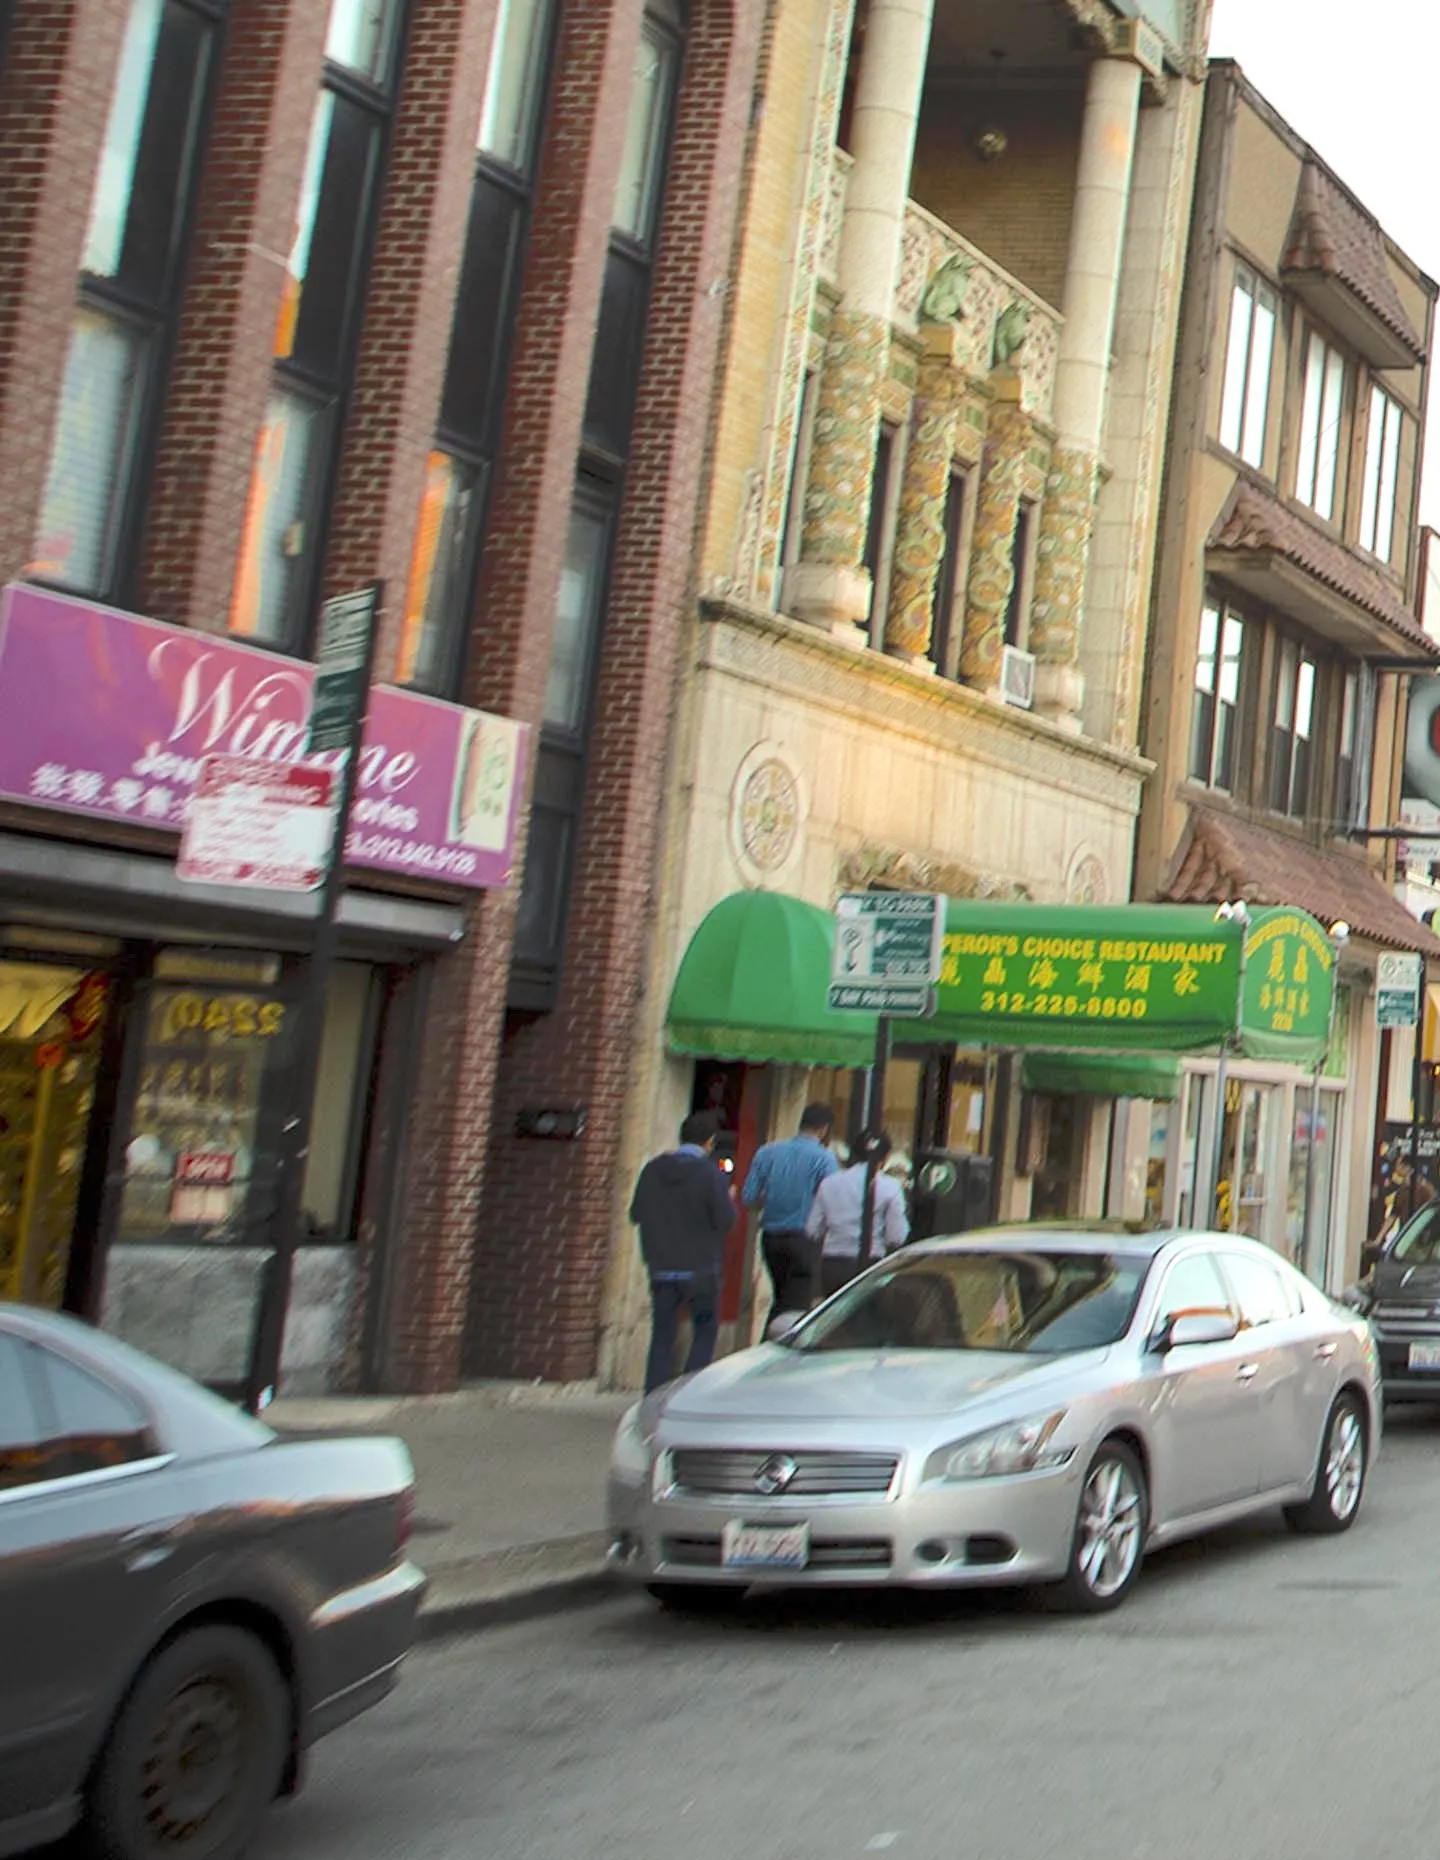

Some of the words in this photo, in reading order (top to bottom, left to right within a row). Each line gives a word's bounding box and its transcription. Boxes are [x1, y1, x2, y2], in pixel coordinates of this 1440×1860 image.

[942, 935, 1018, 956] PEROR'S
[1023, 937, 1095, 960] CHOICE
[1099, 941, 1227, 964] RESTAURANT
